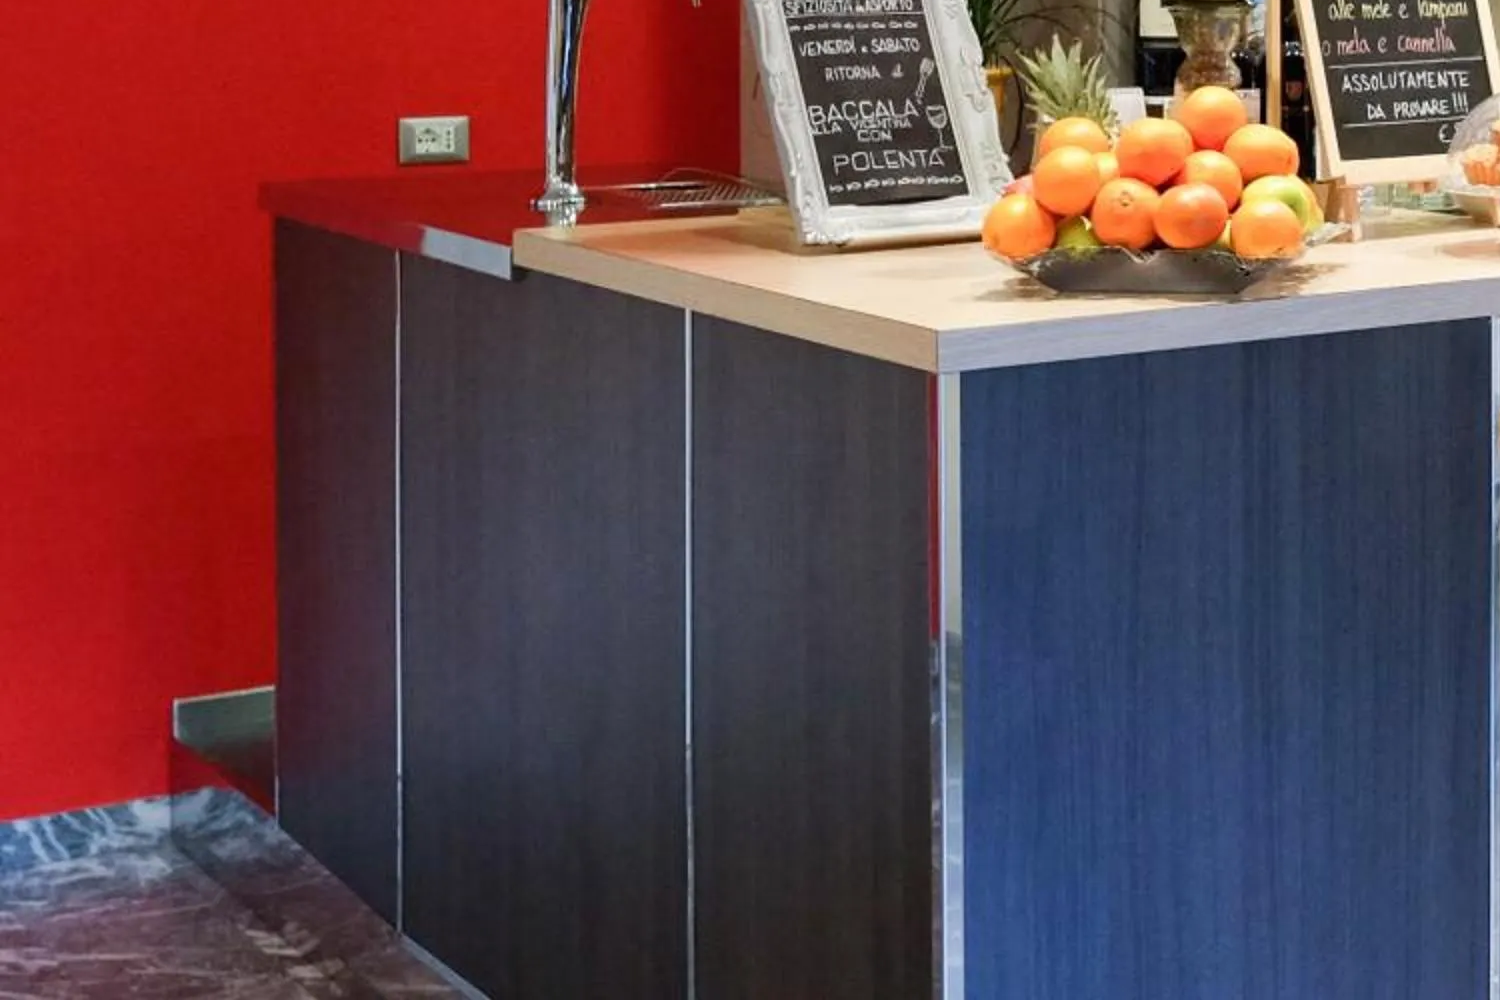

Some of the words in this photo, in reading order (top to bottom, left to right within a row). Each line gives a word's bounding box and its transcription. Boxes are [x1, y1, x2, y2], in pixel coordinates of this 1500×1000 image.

[1398, 3, 1409, 19] e
[871, 37, 921, 55] SABATO
[1337, 26, 1371, 57] mela
[1377, 36, 1388, 54] e
[825, 63, 881, 82] RITORNA
[1341, 70, 1471, 93] ASSOLUTAMENTE
[1367, 103, 1387, 120] DA
[857, 129, 893, 142] CON
[832, 148, 945, 176] POLENTA
